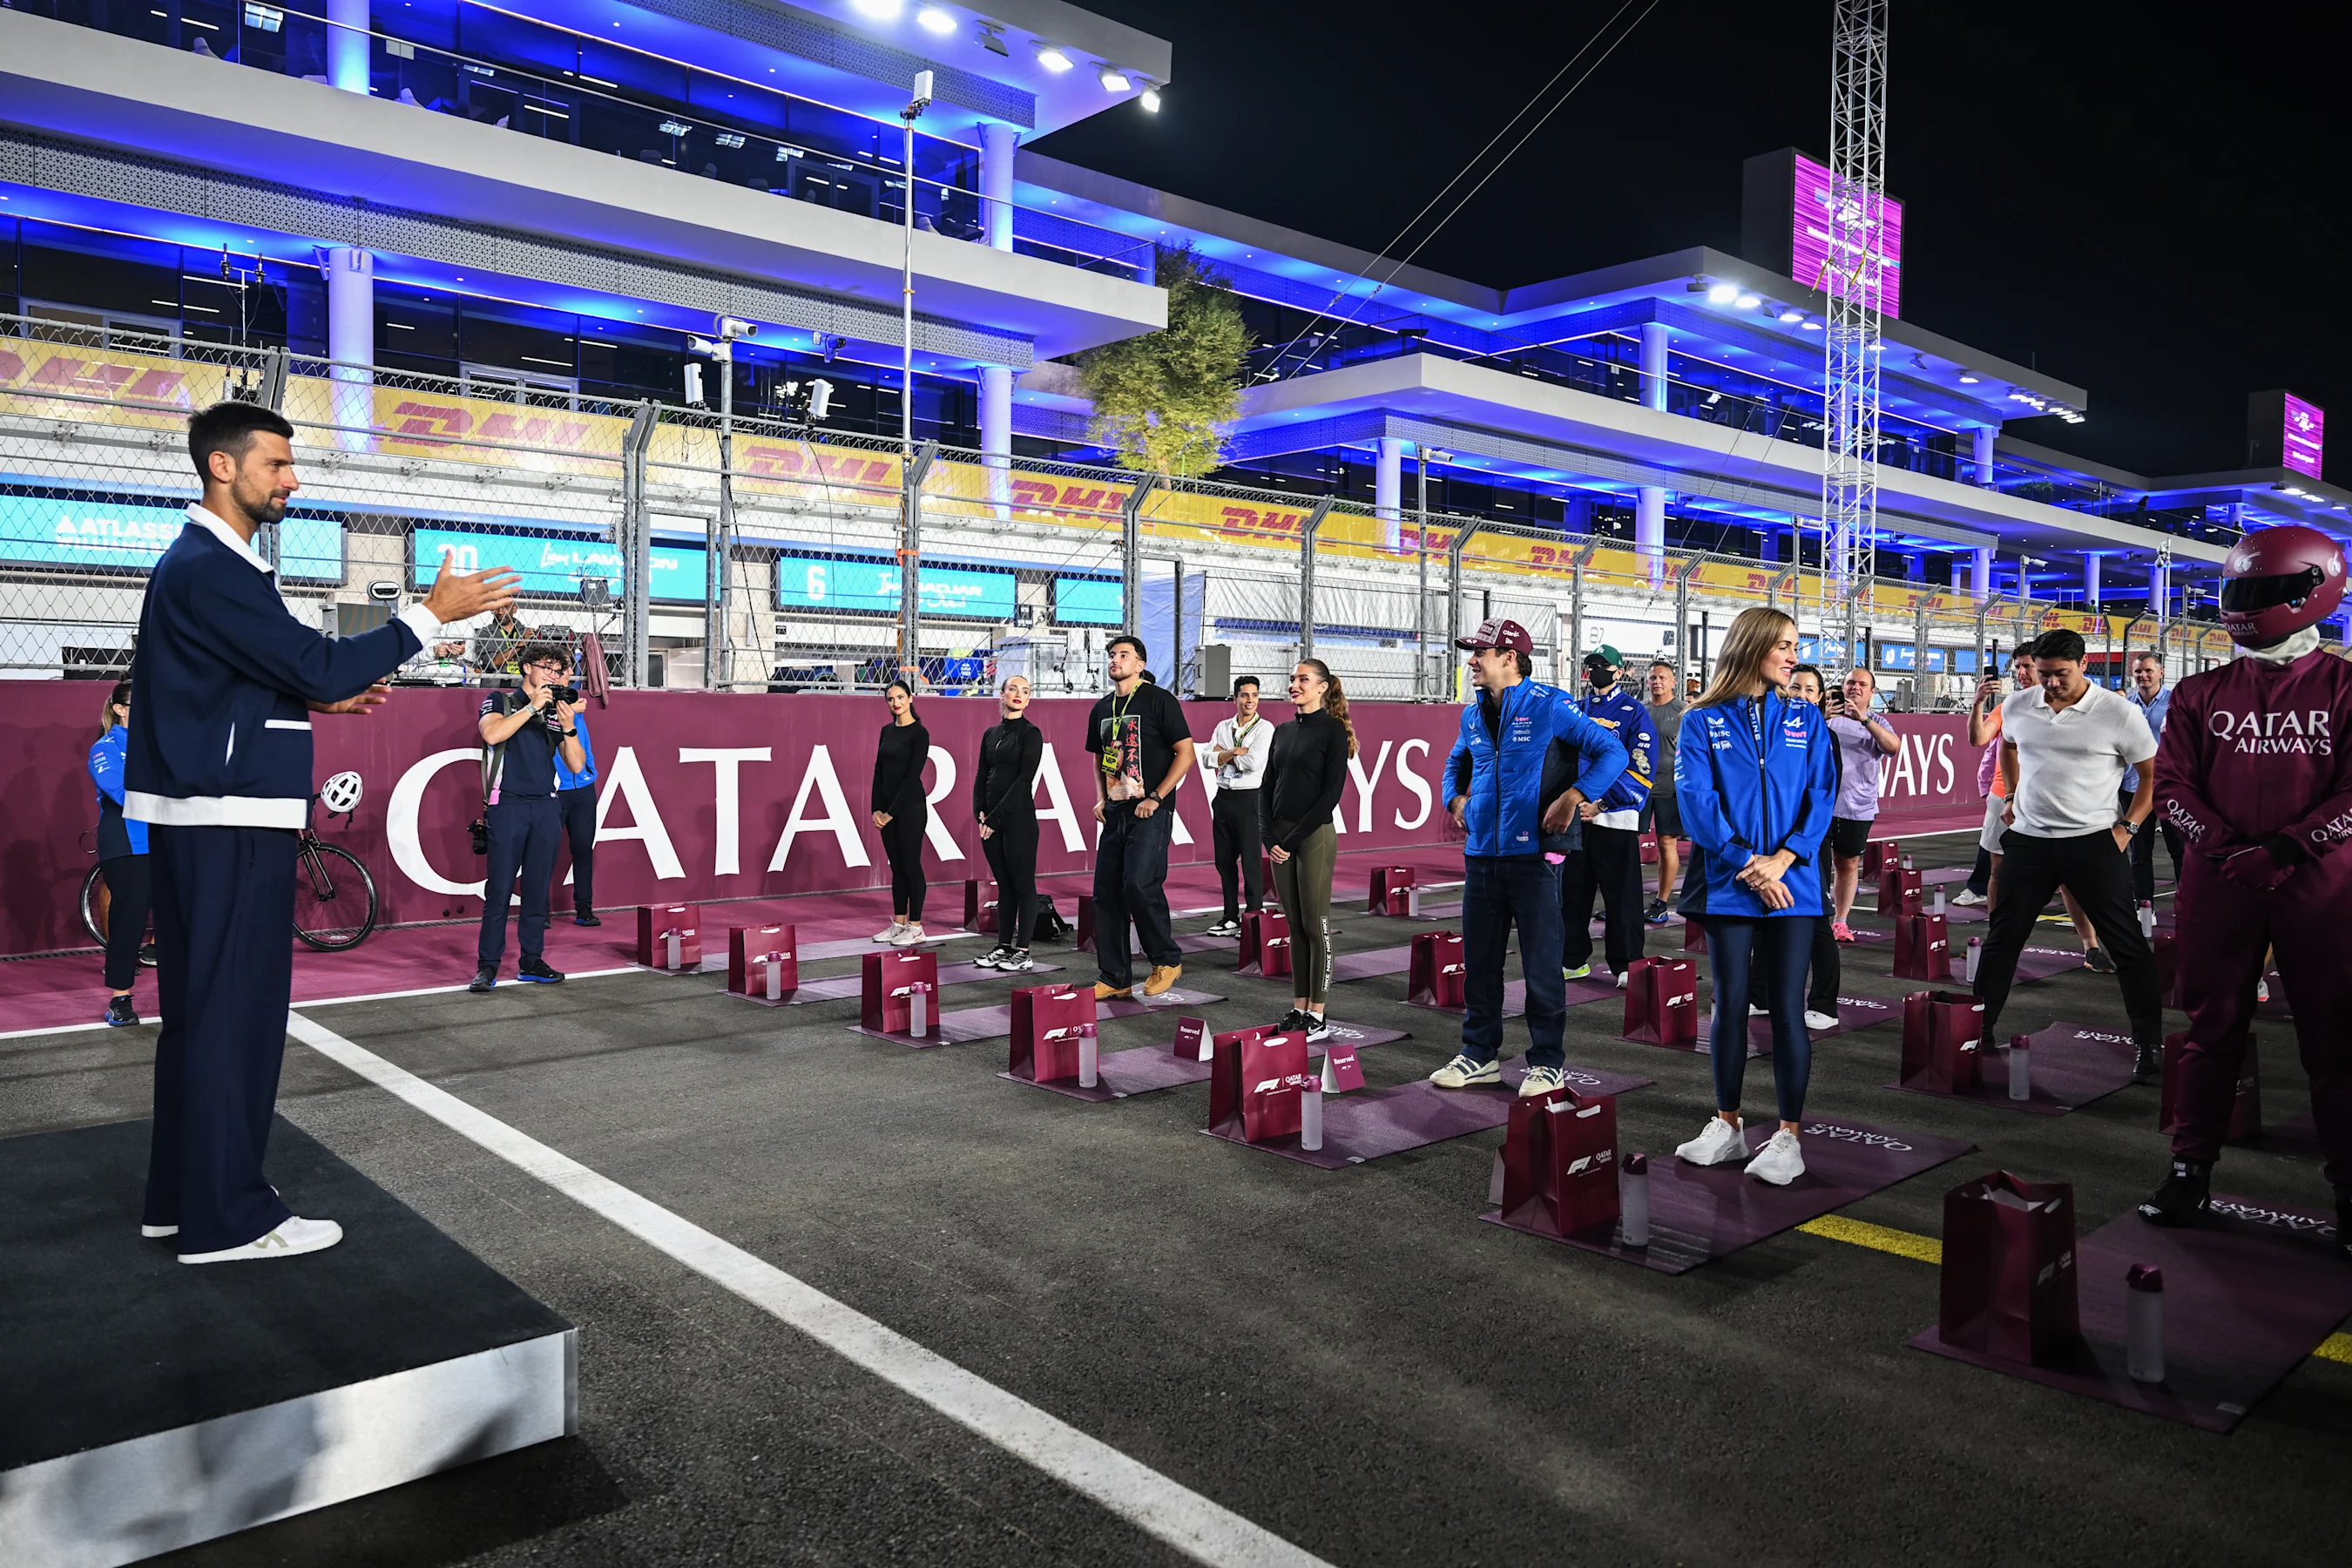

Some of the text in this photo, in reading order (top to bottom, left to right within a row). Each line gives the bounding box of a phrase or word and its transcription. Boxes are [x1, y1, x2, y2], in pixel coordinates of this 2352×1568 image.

[389, 401, 603, 460] DHL
[739, 445, 902, 496] DHL
[1011, 479, 1127, 524] DHL
[572, 552, 678, 571] LAWON
[808, 565, 826, 600] 6
[2082, 616, 2109, 633] DHL
[2224, 622, 2256, 632] QATAR
[2208, 709, 2329, 741] QATAR
[2234, 737, 2331, 755] AIRWAYS
[386, 743, 965, 907] QATAR
[2166, 799, 2206, 836] QATAR
[1179, 1025, 1200, 1036] Reserved
[1333, 1055, 1355, 1065] Reserved
[1254, 1078, 1281, 1093] F1
[1285, 1073, 1302, 1084] QATAR
[1567, 1155, 1592, 1175] F1
[1595, 1149, 1612, 1161] QATAR
[2209, 1200, 2327, 1225] AIRWAYS
